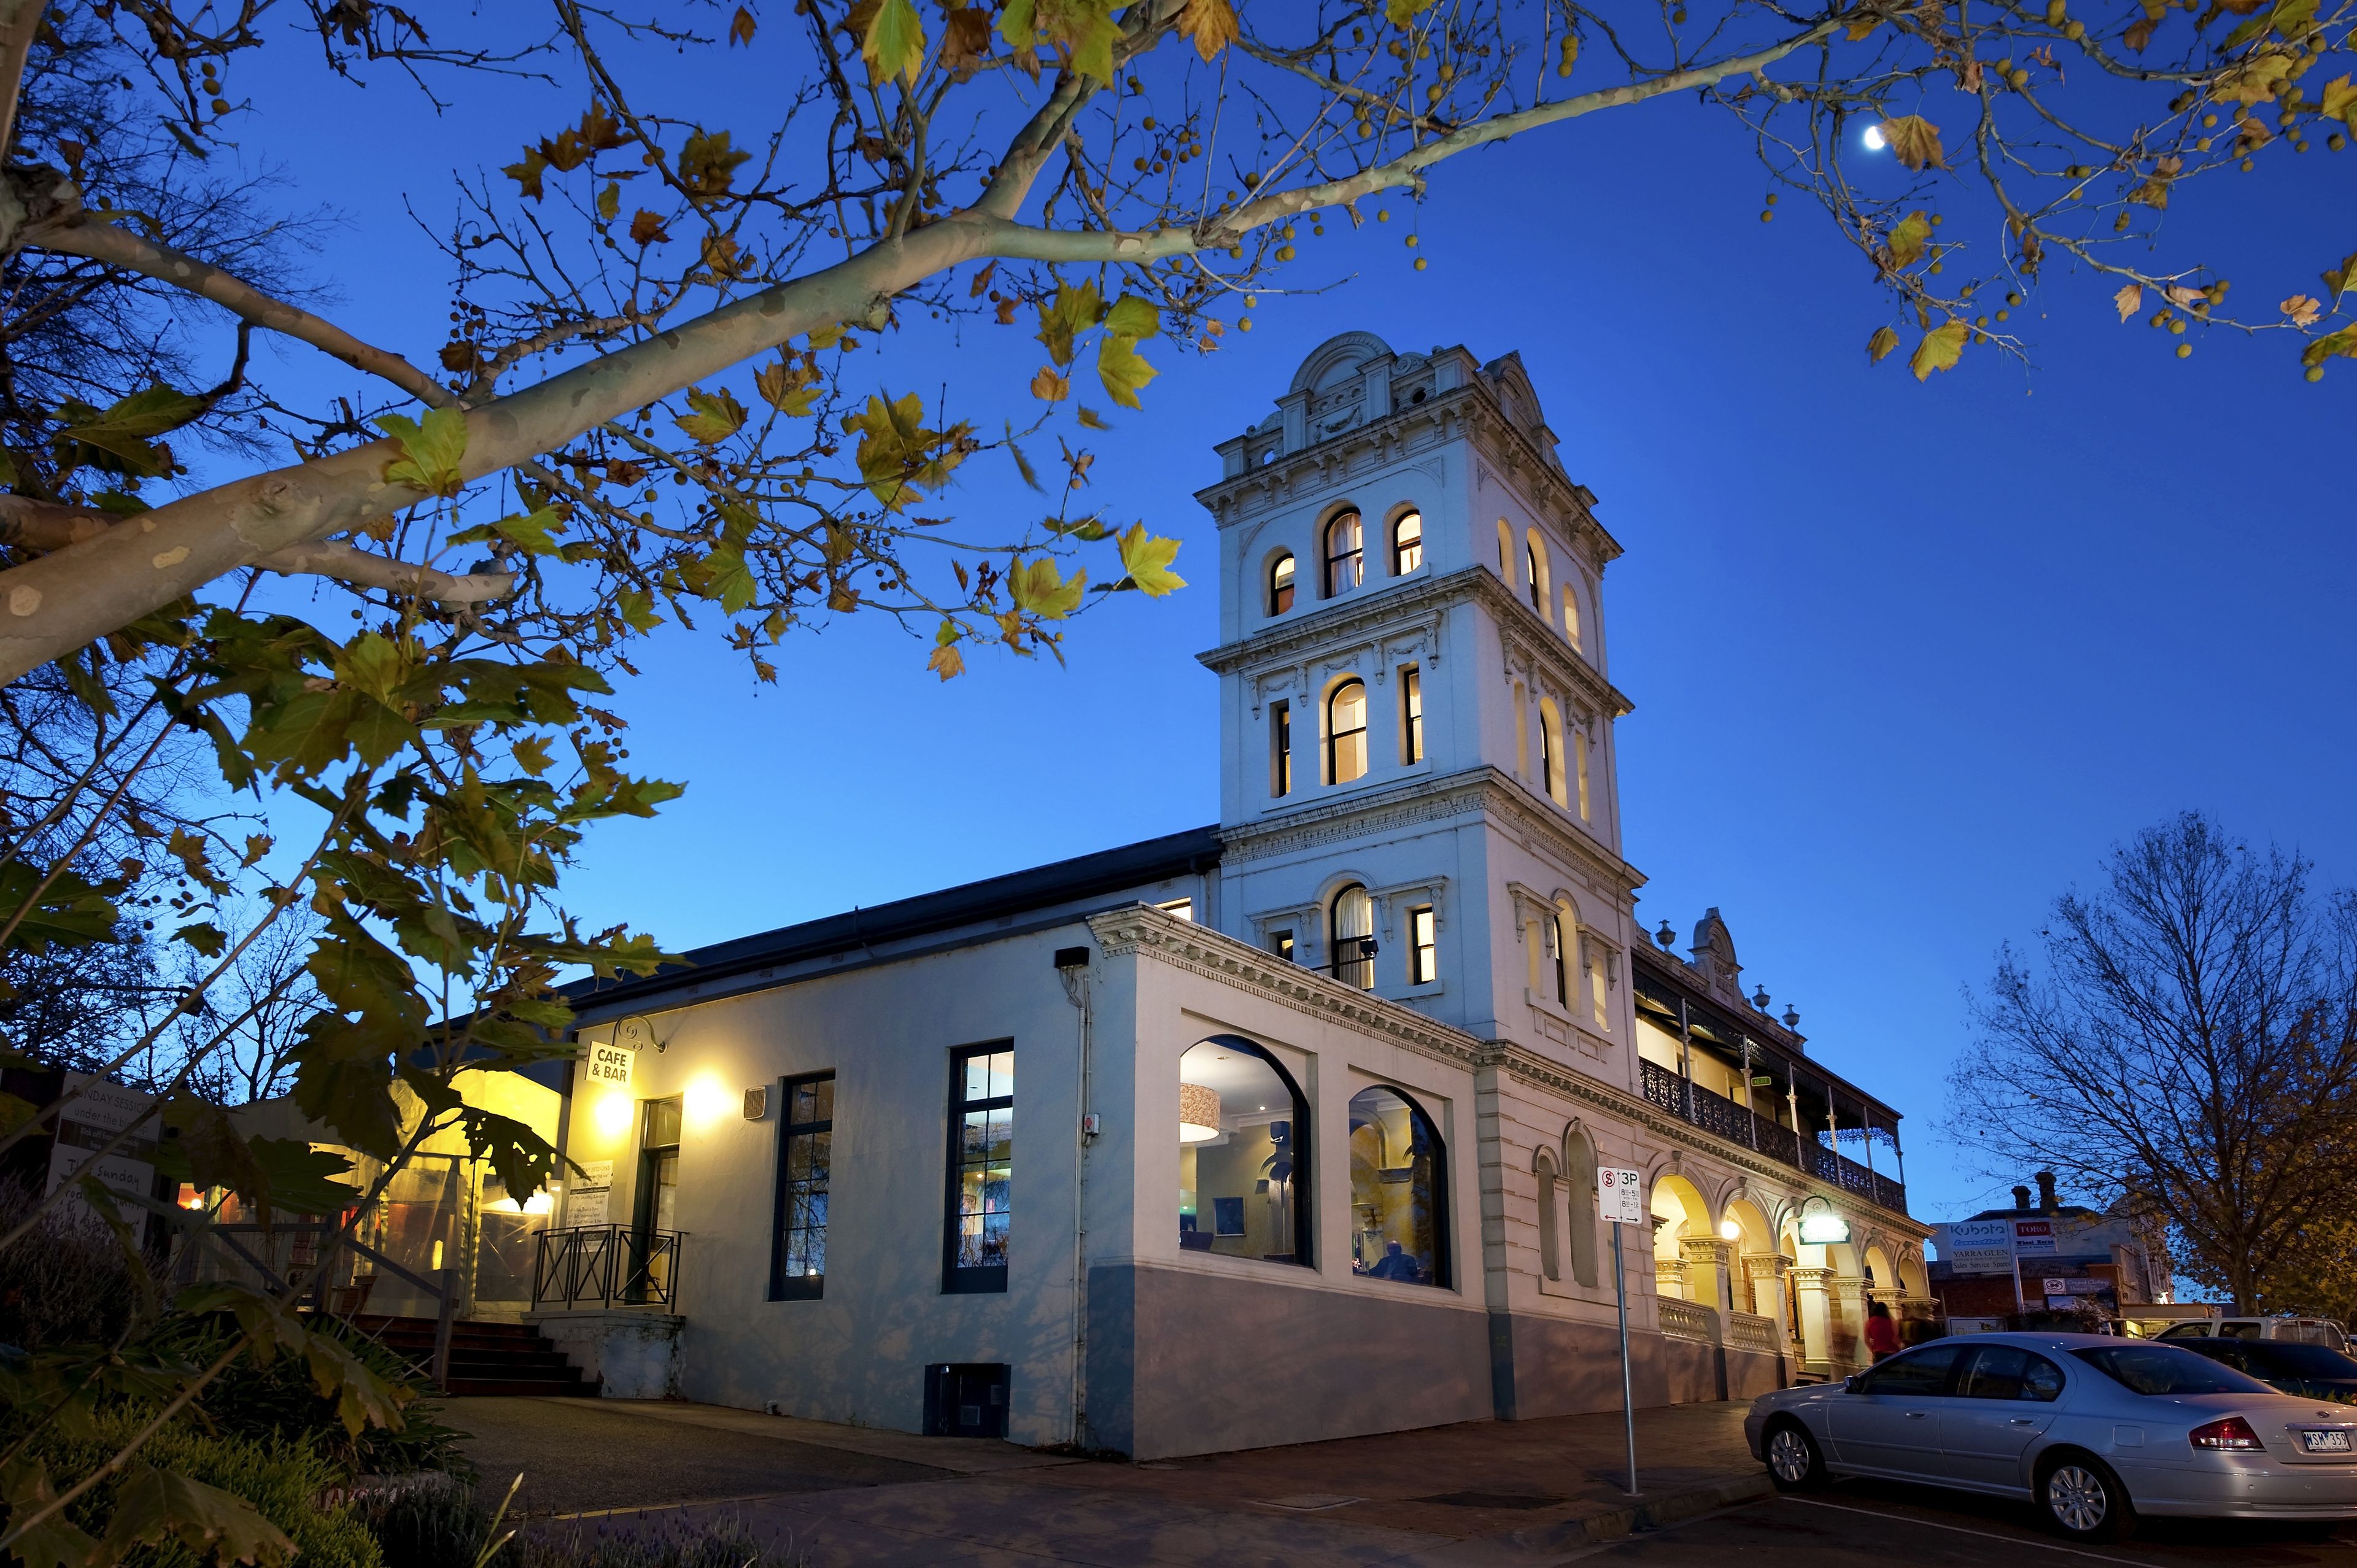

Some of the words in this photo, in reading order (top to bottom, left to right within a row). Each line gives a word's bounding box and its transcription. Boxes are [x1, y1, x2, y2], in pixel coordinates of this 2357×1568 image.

[597, 1049, 627, 1067] CAFE
[592, 1063, 600, 1076] &
[603, 1065, 627, 1082] BAR
[74, 1107, 101, 1121] under
[104, 1113, 118, 1126] the
[68, 1158, 93, 1175] Ts
[98, 1166, 139, 1192] Sunday
[1622, 1172, 1638, 1186] 3P
[1951, 1224, 2005, 1235] Kubota
[2305, 1432, 2326, 1446] WSM
[2329, 1434, 2347, 1446] 359
